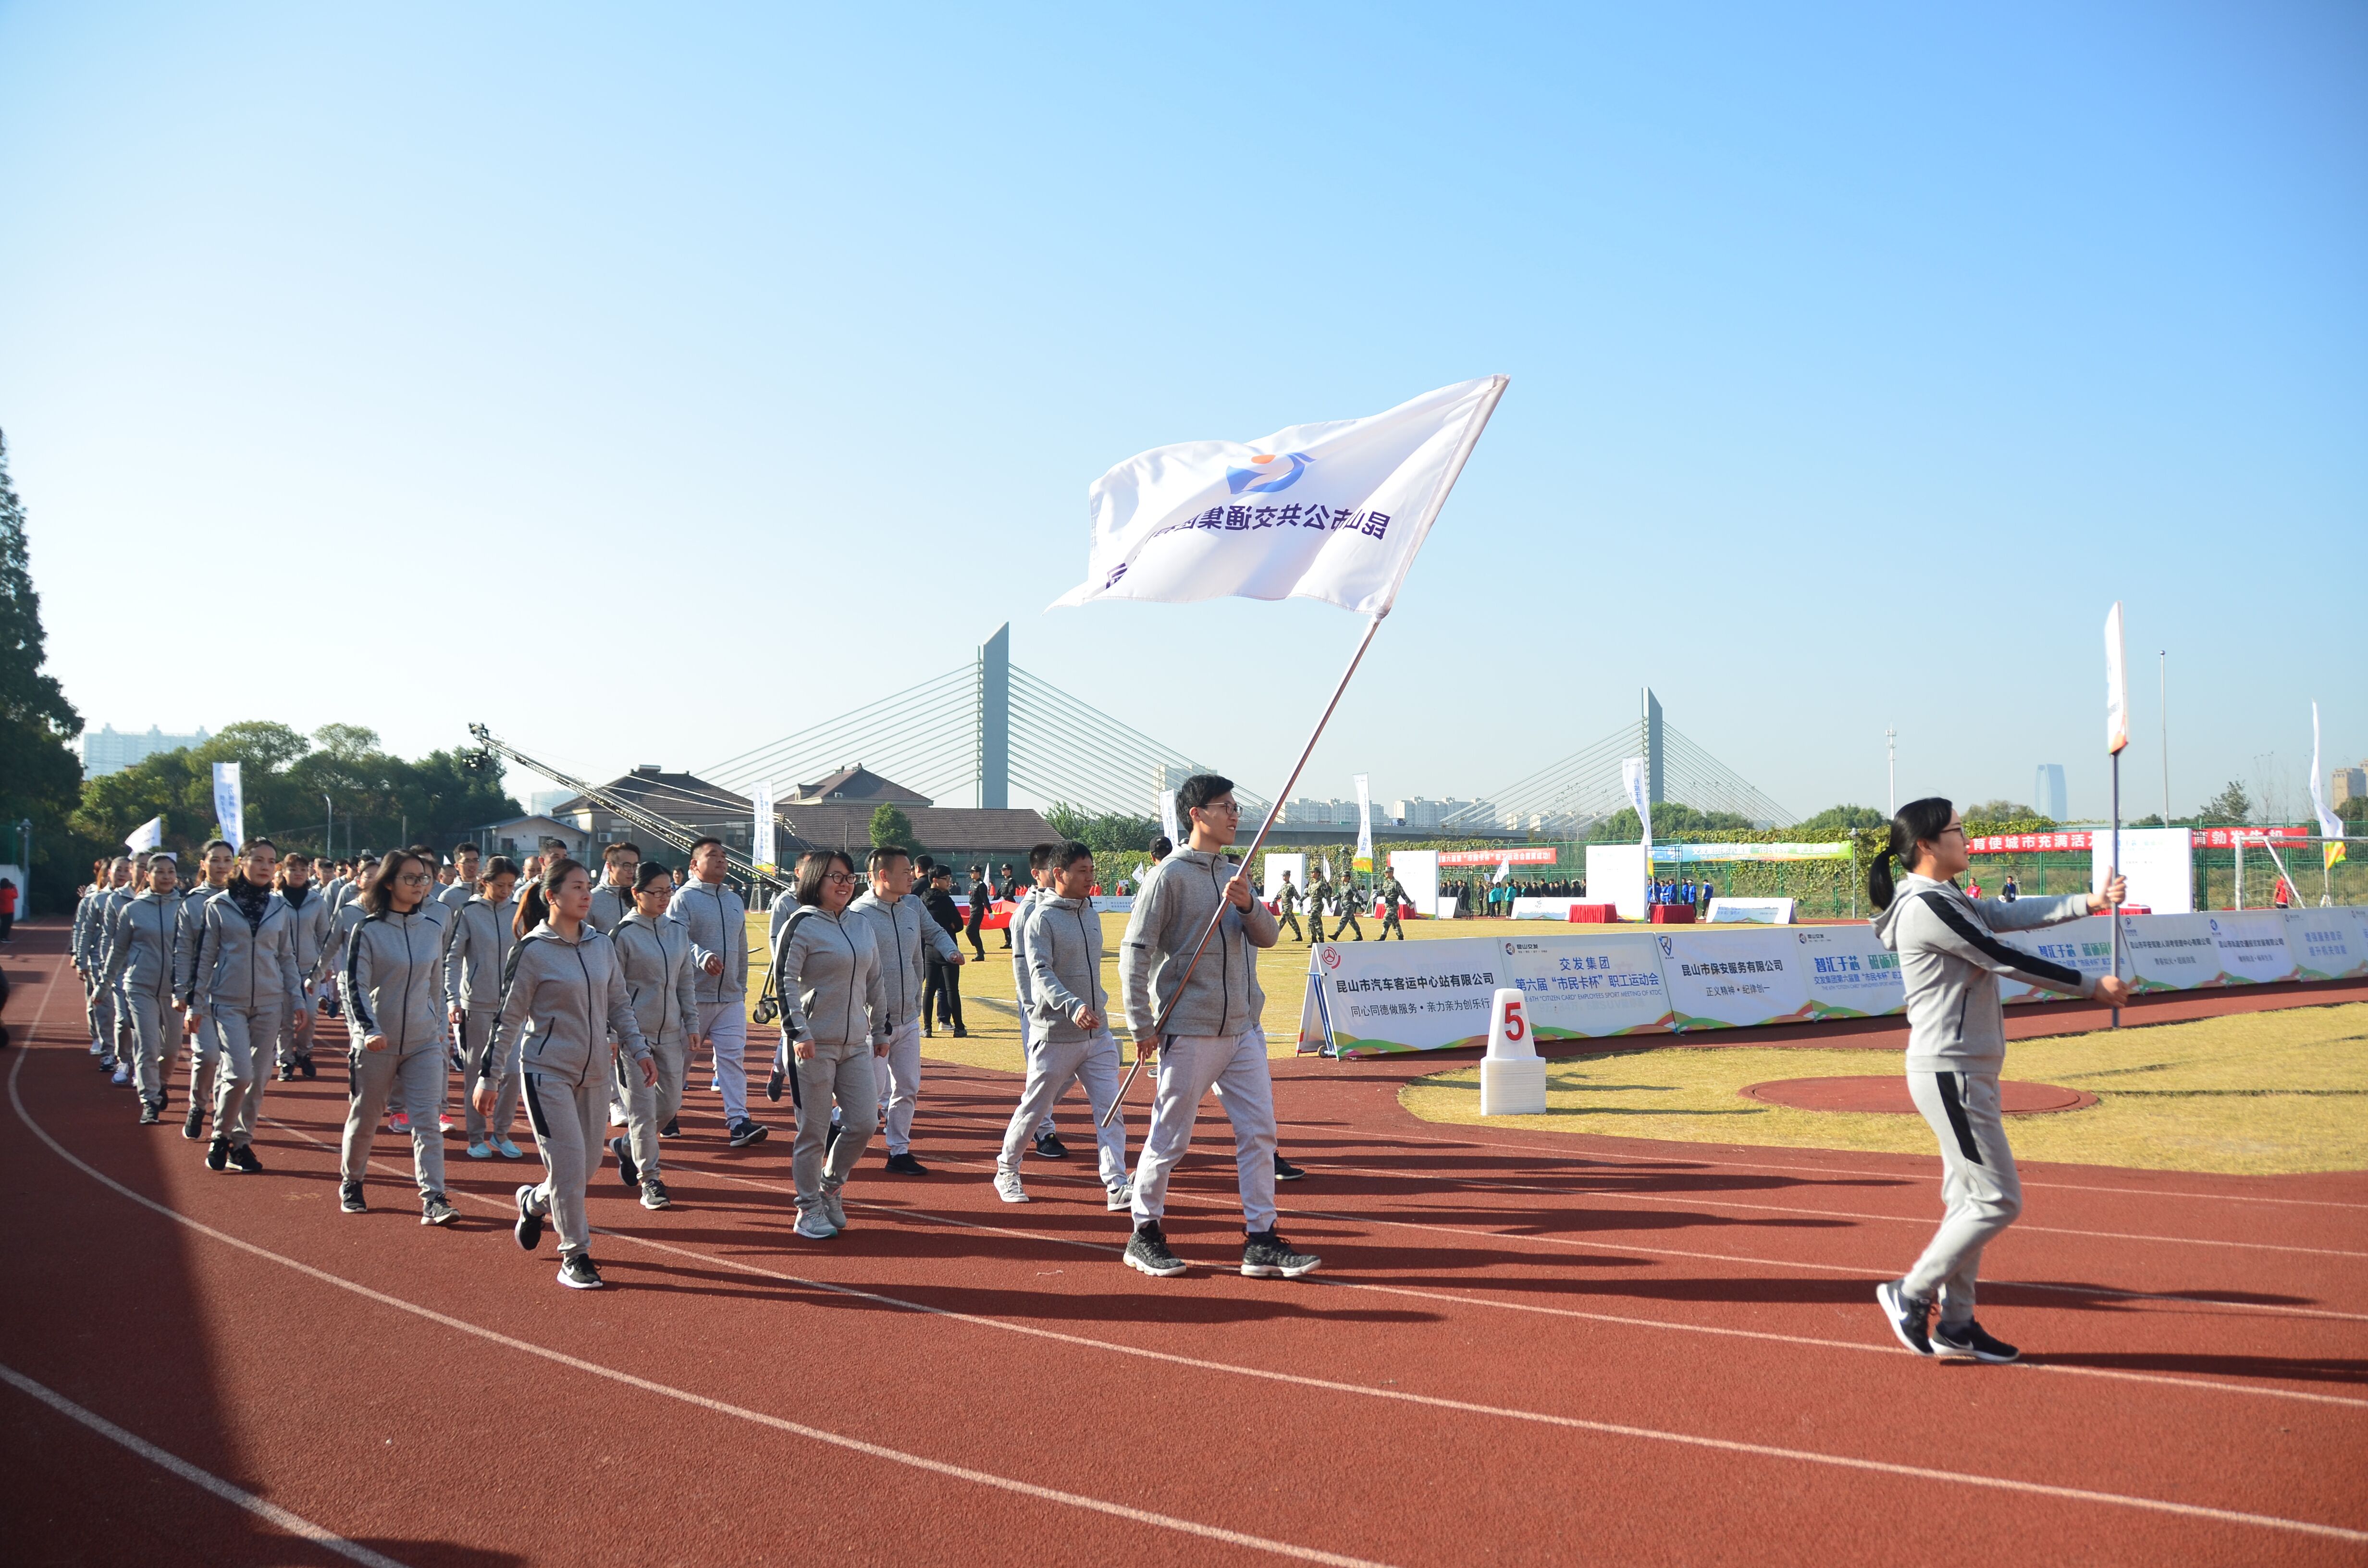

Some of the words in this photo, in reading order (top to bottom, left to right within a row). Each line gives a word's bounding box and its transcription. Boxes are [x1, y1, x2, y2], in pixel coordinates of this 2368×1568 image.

[1966, 834, 2093, 850] 育使城市充满活
[1559, 956, 1610, 971] 交发集团
[1682, 959, 1783, 977] 昆山市保安服务有限公司
[1814, 956, 1861, 973] 智汇于芯
[1336, 972, 1494, 993] 昆山市汽车客运中心站有限公司
[1505, 1002, 1525, 1041] 5
